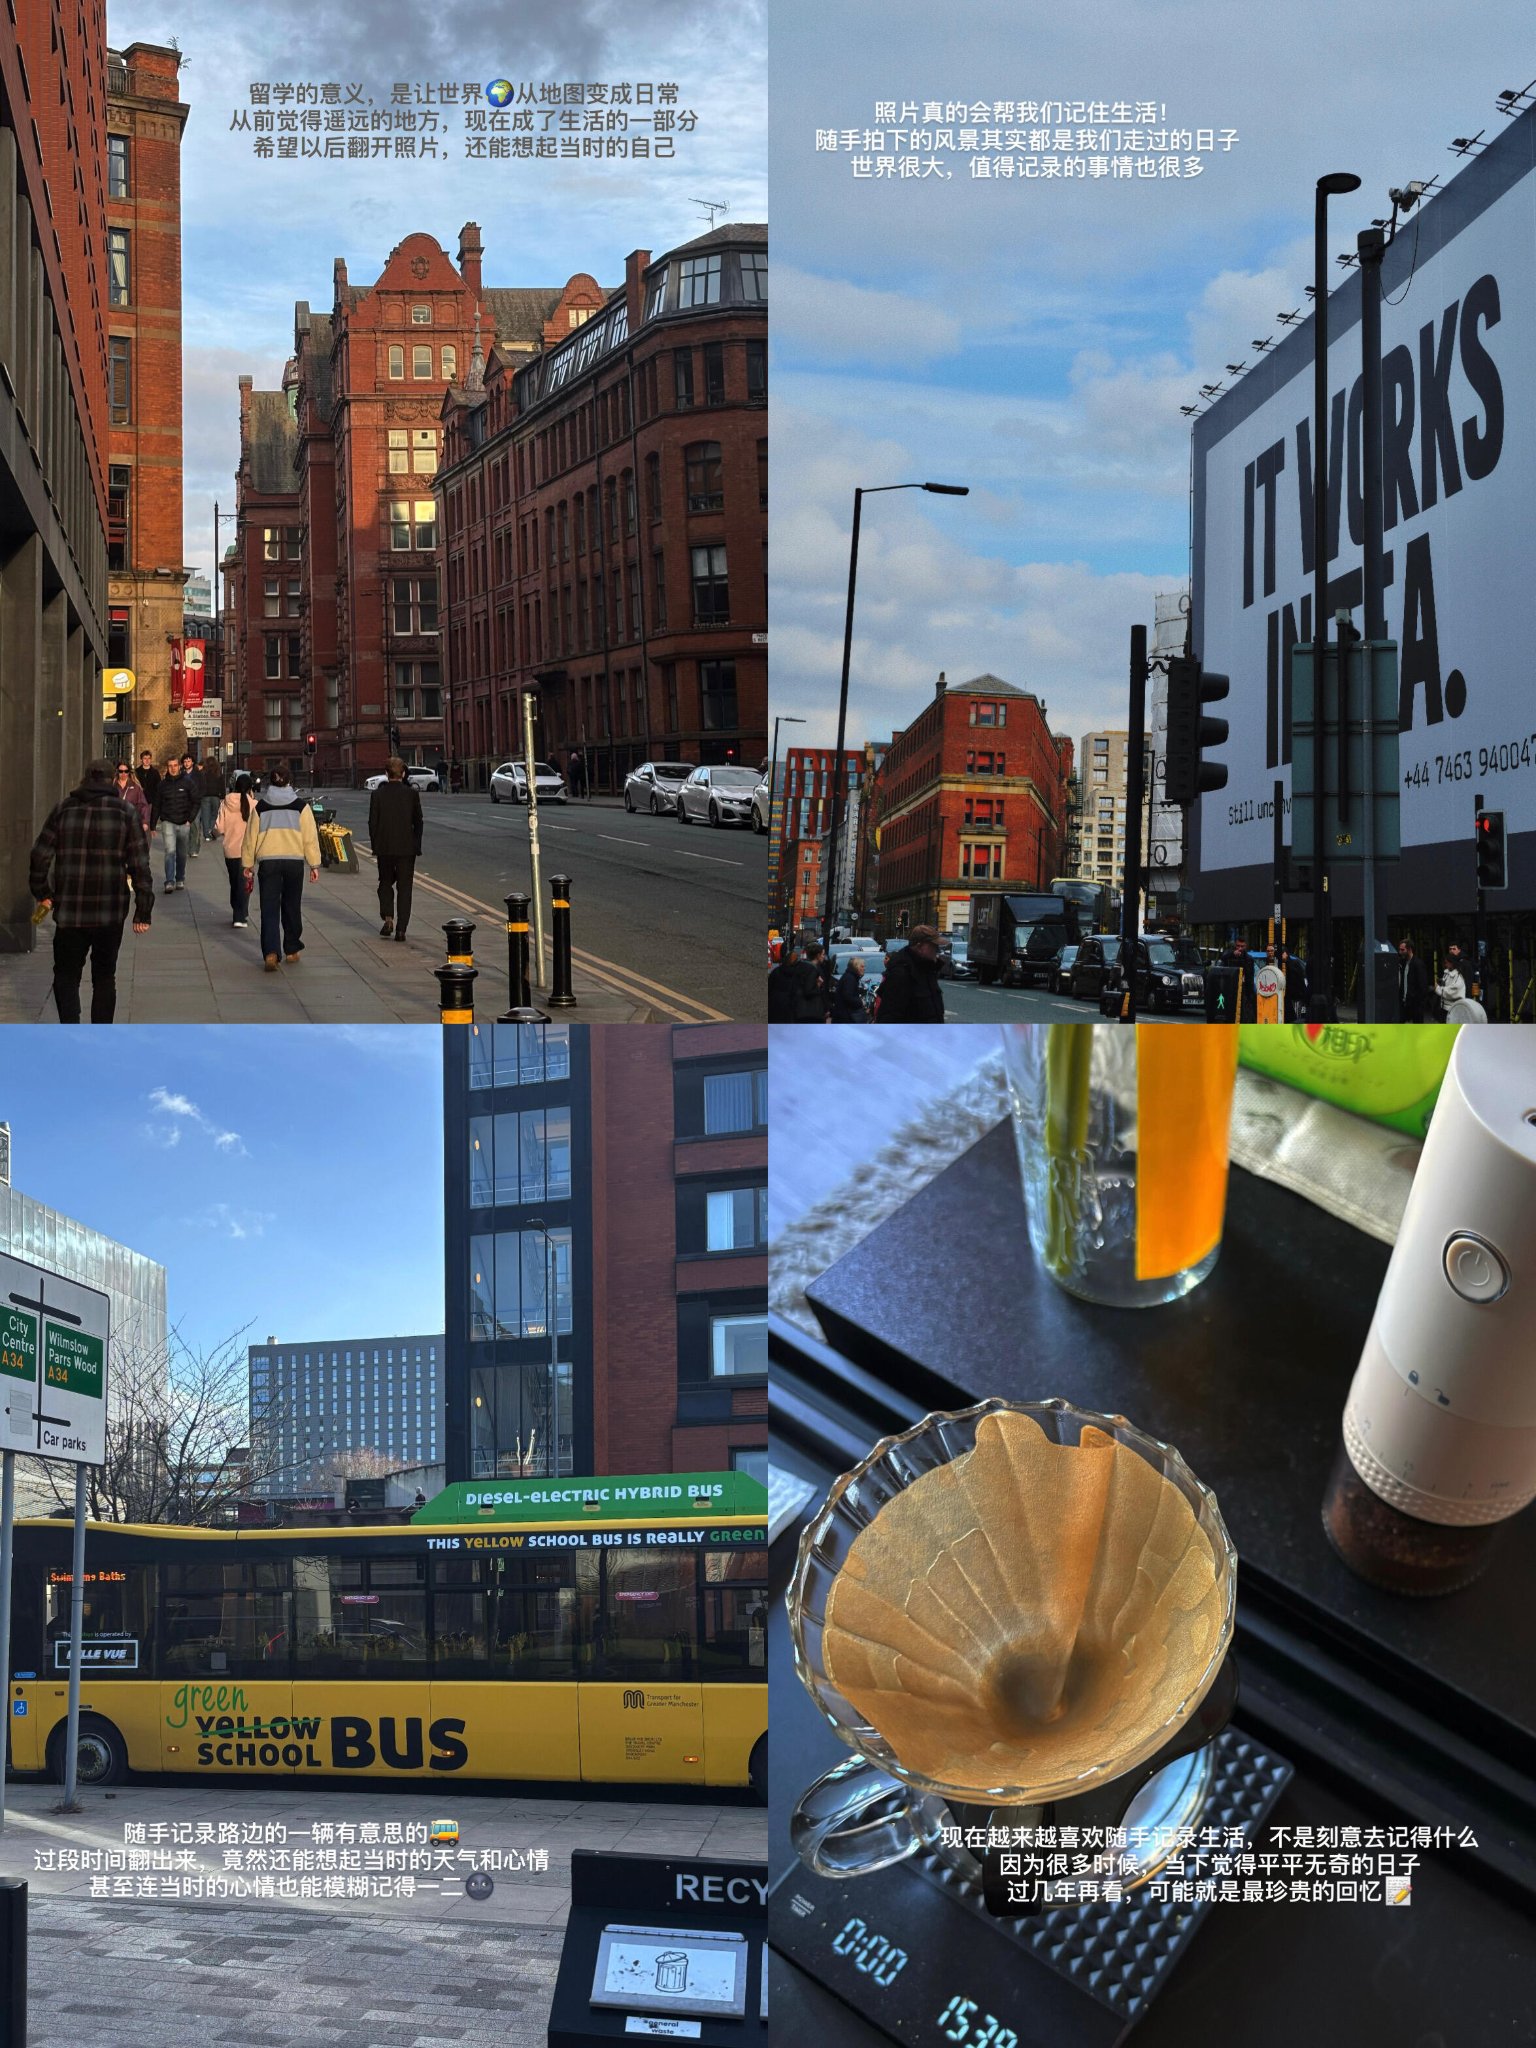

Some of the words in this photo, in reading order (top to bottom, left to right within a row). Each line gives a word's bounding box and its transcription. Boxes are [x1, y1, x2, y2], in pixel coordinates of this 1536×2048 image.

[1243, 436, 1285, 610] IT
[1435, 750, 1473, 785] 7463
[9, 1315, 29, 1337] City
[2, 1332, 35, 1355] Centre
[48, 1331, 89, 1356] Wilmslow
[2, 1351, 24, 1370] A34
[48, 1348, 72, 1368] Parrs
[74, 1355, 97, 1375] Wood
[48, 1366, 68, 1384] A34
[43, 1430, 60, 1448] Car
[62, 1434, 87, 1451] parks
[615, 1485, 682, 1501] HYBRID
[687, 1484, 723, 1498] BUS
[426, 1537, 460, 1550] THIS
[528, 1534, 588, 1548] SCHOOL
[592, 1533, 623, 1547] BUS
[626, 1532, 642, 1545] IS
[99, 1571, 126, 1581] Baths
[100, 1631, 124, 1639] operated
[66, 1649, 102, 1660] LLE
[103, 1649, 127, 1659] VUE
[166, 1683, 249, 1729] green
[330, 1715, 469, 1772] BUS
[197, 1743, 322, 1768] SCHOOL
[675, 1873, 768, 1906] RECY
[832, 1917, 908, 1987] 0:00
